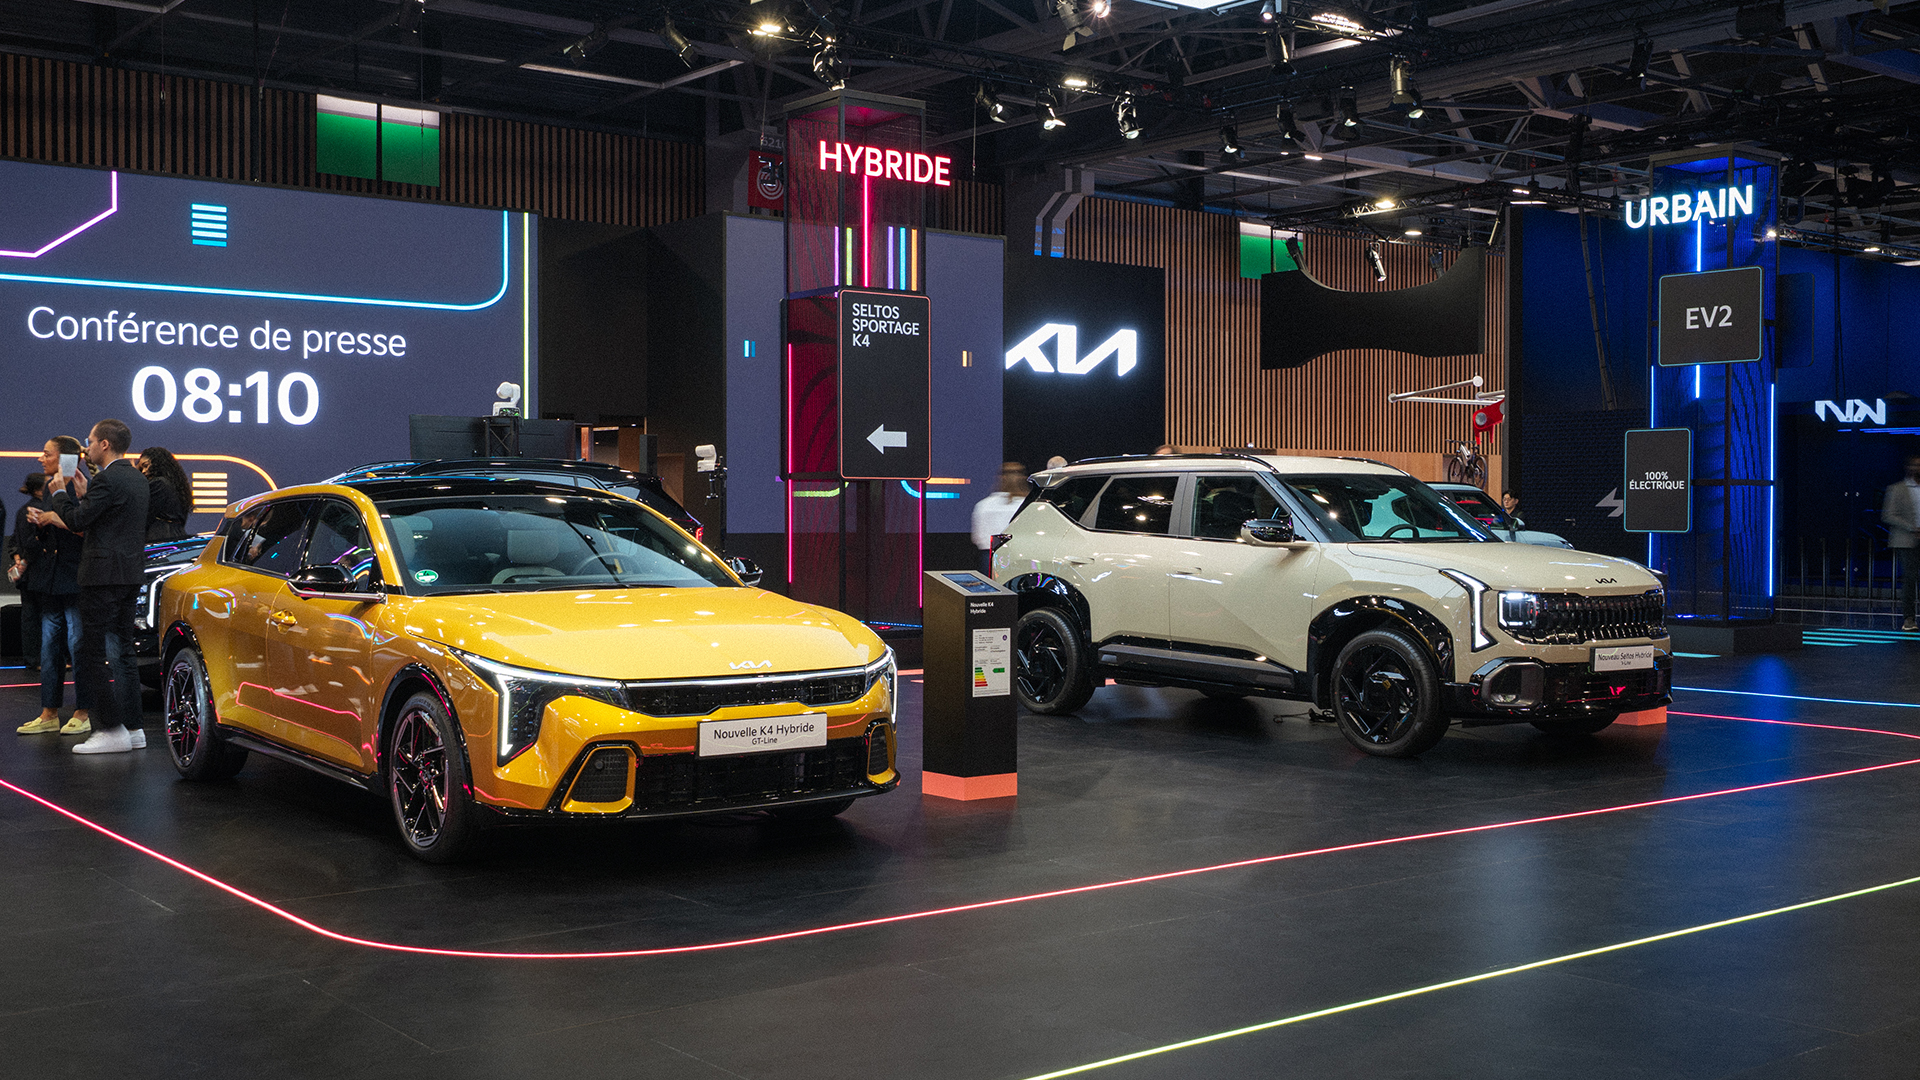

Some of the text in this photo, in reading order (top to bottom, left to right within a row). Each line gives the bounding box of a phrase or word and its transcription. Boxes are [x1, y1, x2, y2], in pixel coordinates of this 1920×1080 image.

[819, 140, 951, 186] HYBRIDE
[1625, 184, 1753, 229] URBAIN
[852, 303, 900, 319] SELTOS
[1686, 305, 1733, 330] EV2
[27, 306, 407, 359] Conférence de presse
[852, 318, 920, 336] SPORTAGE
[852, 333, 870, 347] K4
[131, 365, 320, 426] 08:10
[1629, 479, 1685, 490] ÉLECTRIQUE
[1644, 471, 1669, 480] 100%
[728, 660, 773, 670] KIA
[713, 722, 815, 740] Nouvelle K4 Hybride
[751, 737, 778, 745] GT-Line
